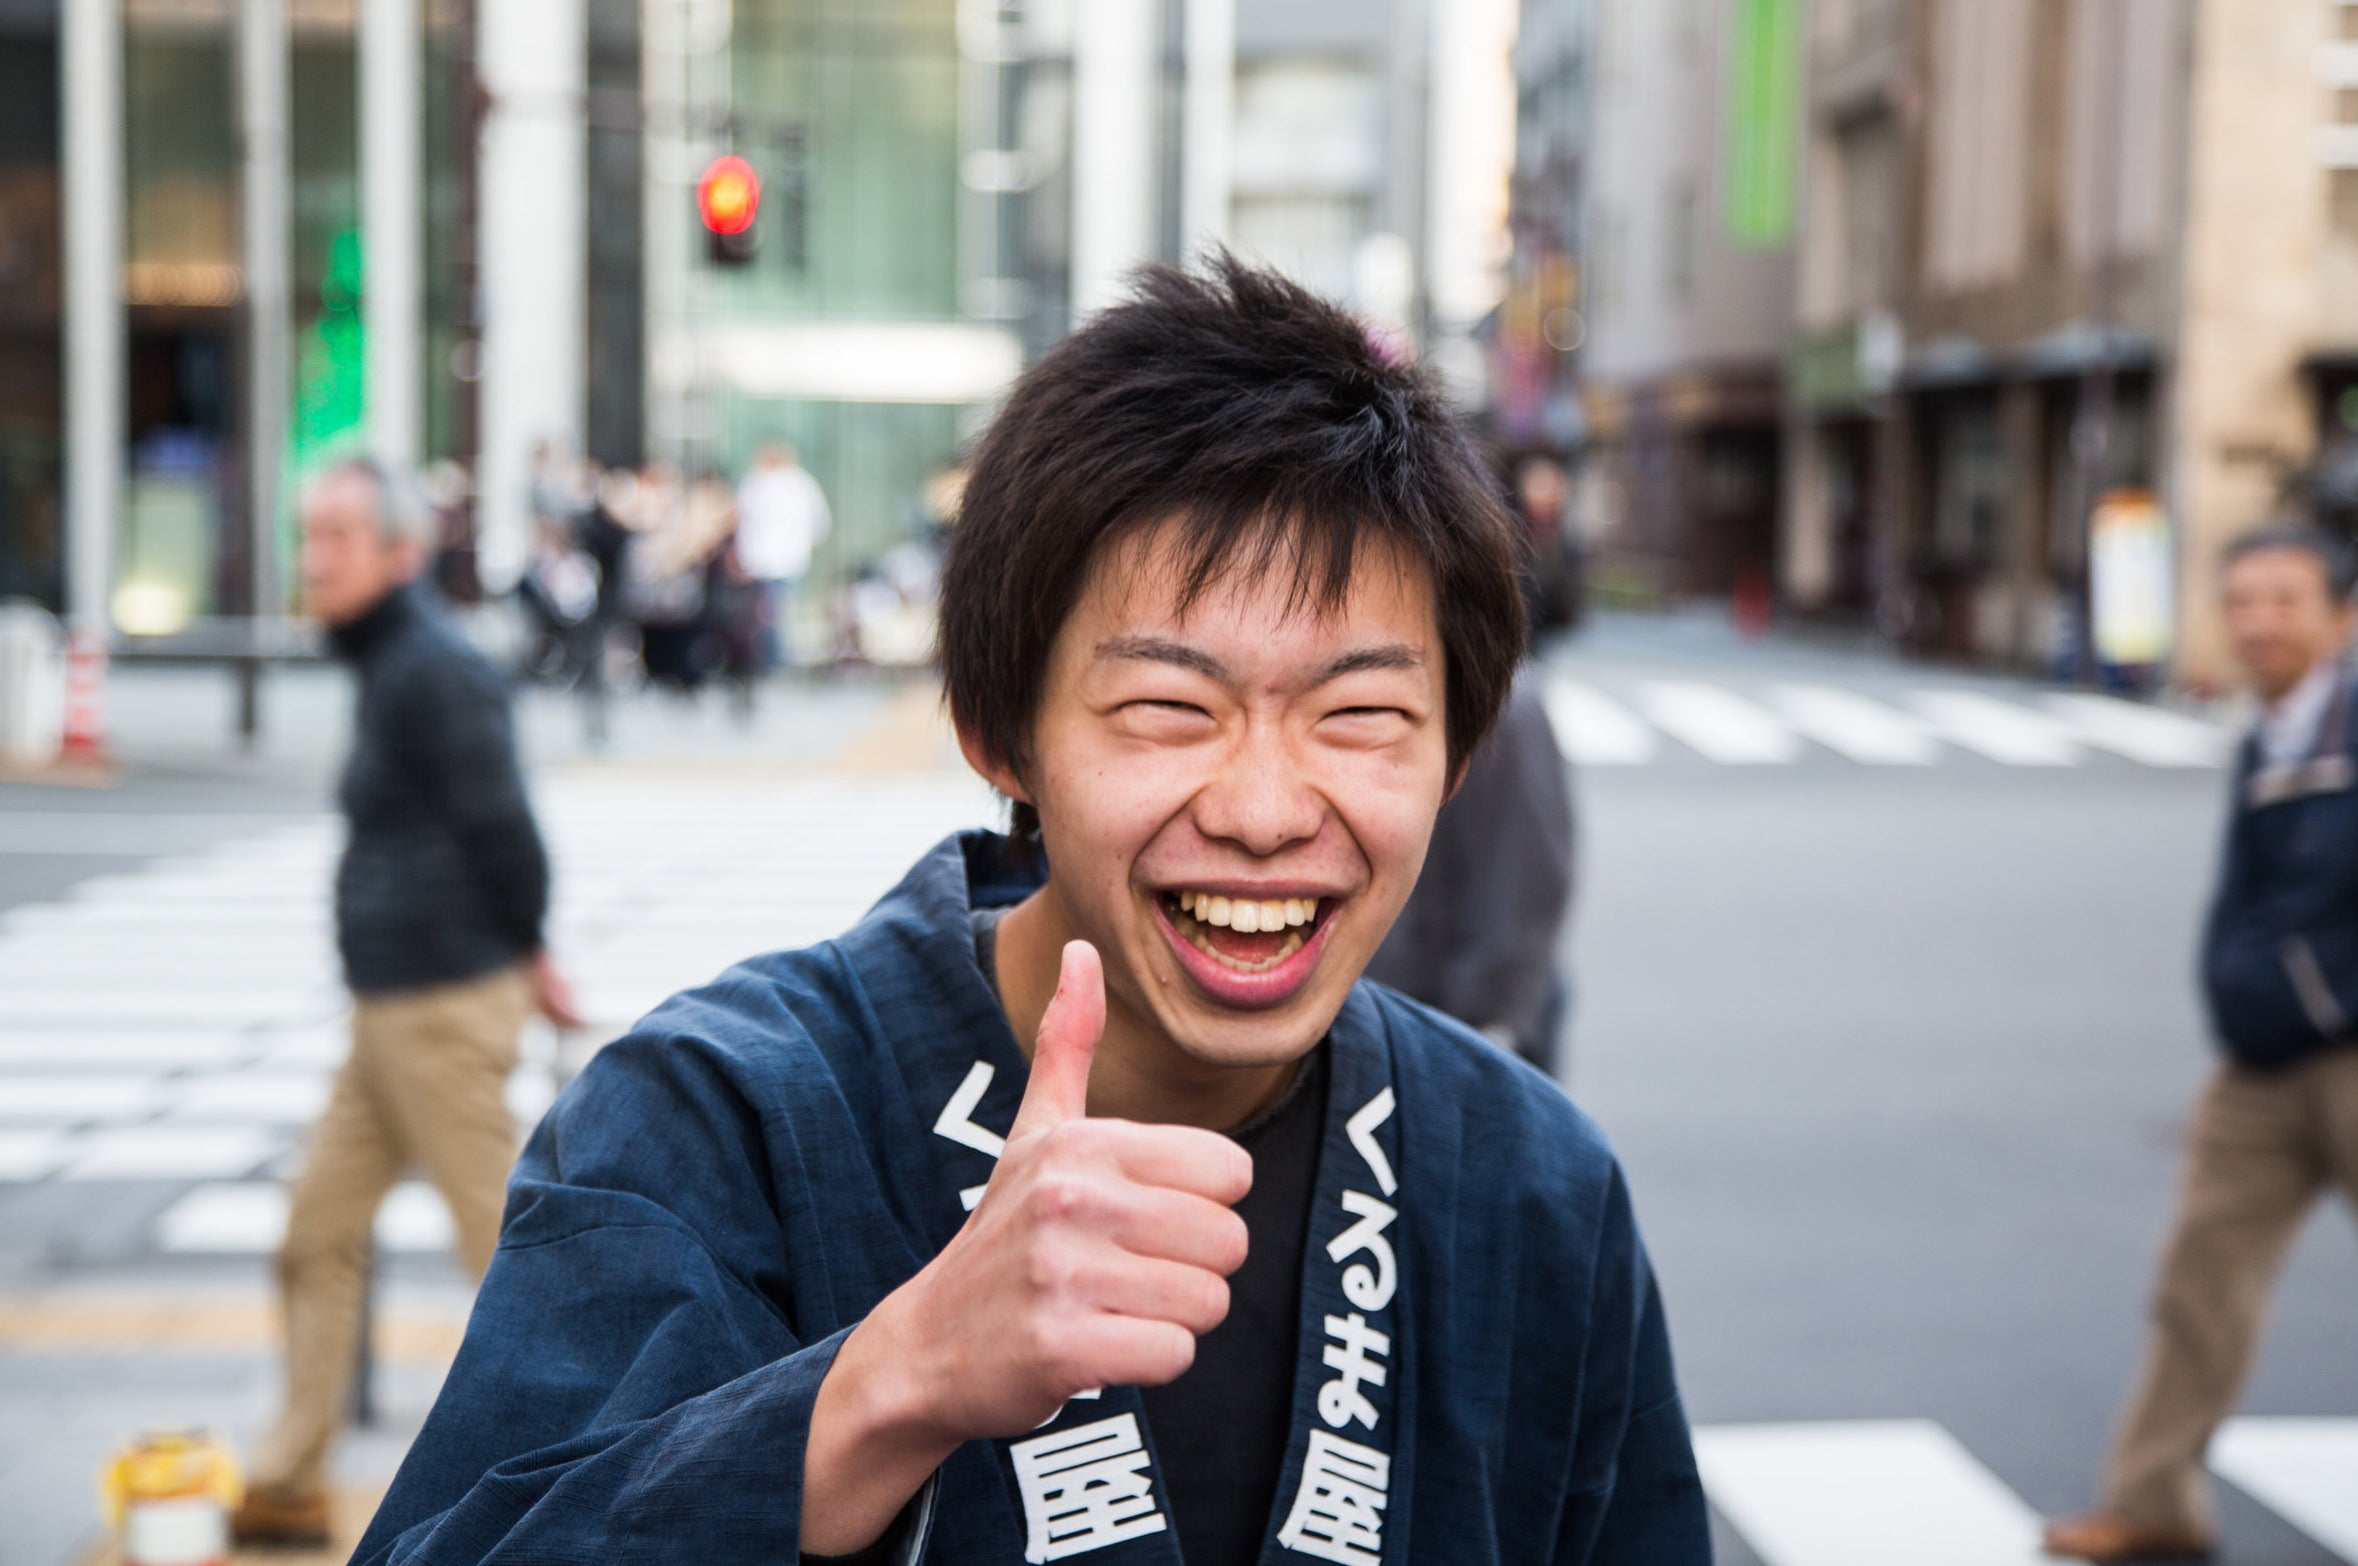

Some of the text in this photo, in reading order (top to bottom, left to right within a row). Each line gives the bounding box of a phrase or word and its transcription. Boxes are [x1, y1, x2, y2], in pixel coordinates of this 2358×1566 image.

[933, 1060, 1167, 1565] く屋
[1277, 1085, 1399, 1566] くるま屋
